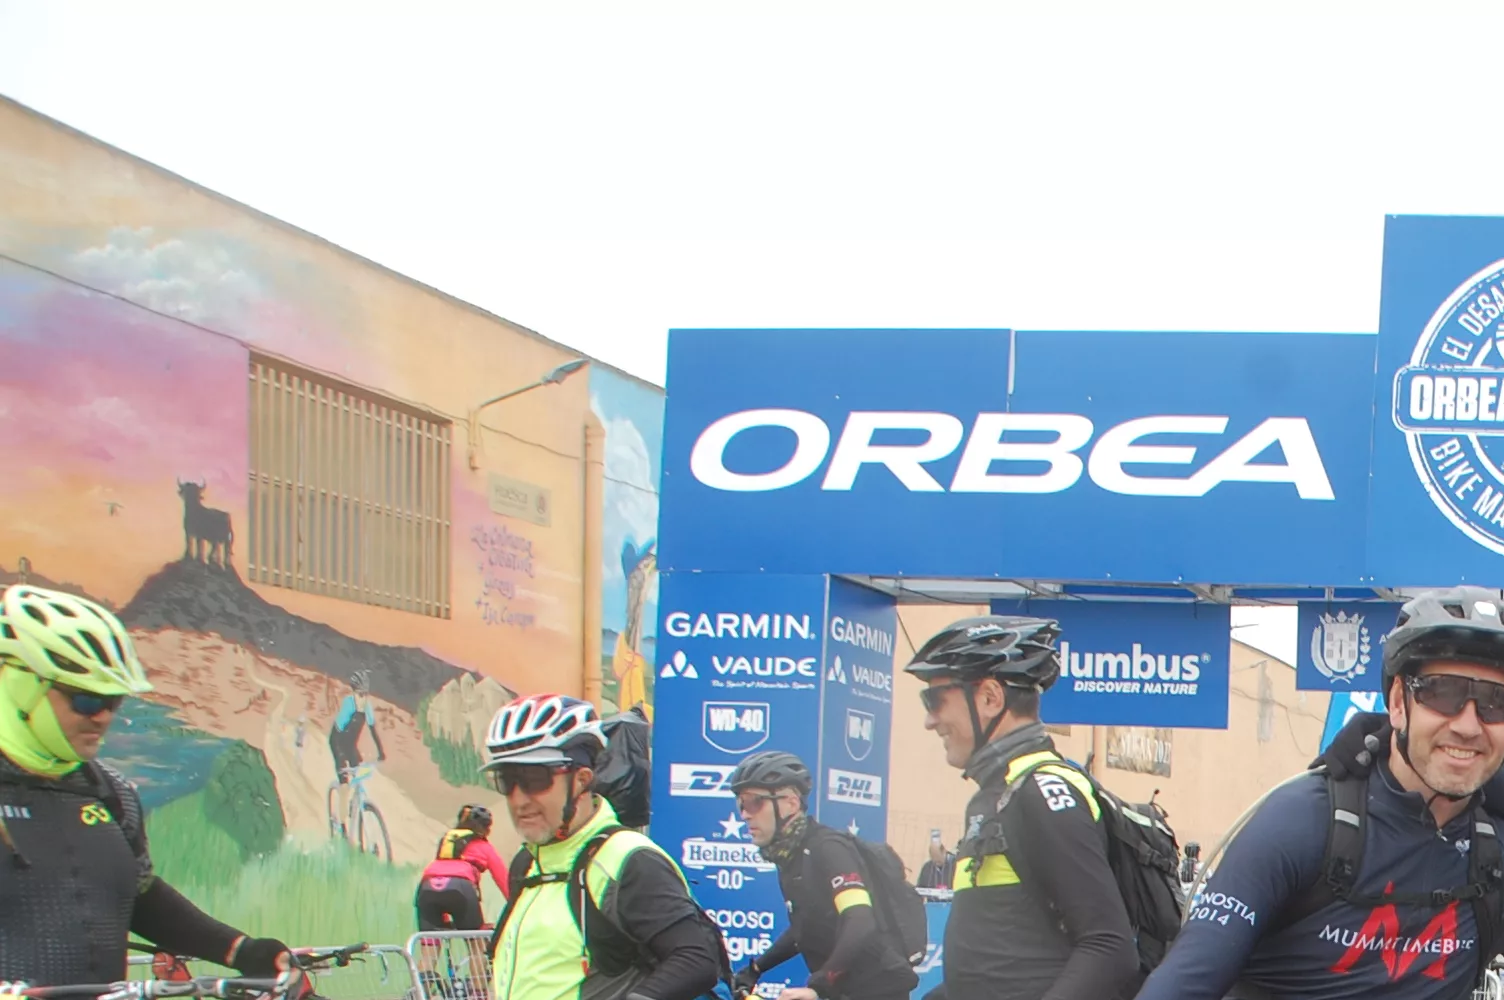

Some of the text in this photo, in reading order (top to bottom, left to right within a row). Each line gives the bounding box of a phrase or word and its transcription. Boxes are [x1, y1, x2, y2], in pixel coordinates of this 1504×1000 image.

[1441, 335, 1473, 361] EL
[690, 408, 1336, 501] ORBEA
[1430, 438, 1479, 501] BIKE
[830, 615, 892, 657] GARMIN
[712, 656, 817, 677] VAUDE
[1060, 641, 1201, 682] lumbus
[852, 664, 893, 692] VAUDE
[1074, 680, 1198, 696] DISCOVER NATURE
[836, 776, 873, 800] DHL
[689, 844, 763, 863] Heineke
[717, 869, 744, 889] 0.0
[705, 909, 774, 929] saosa
